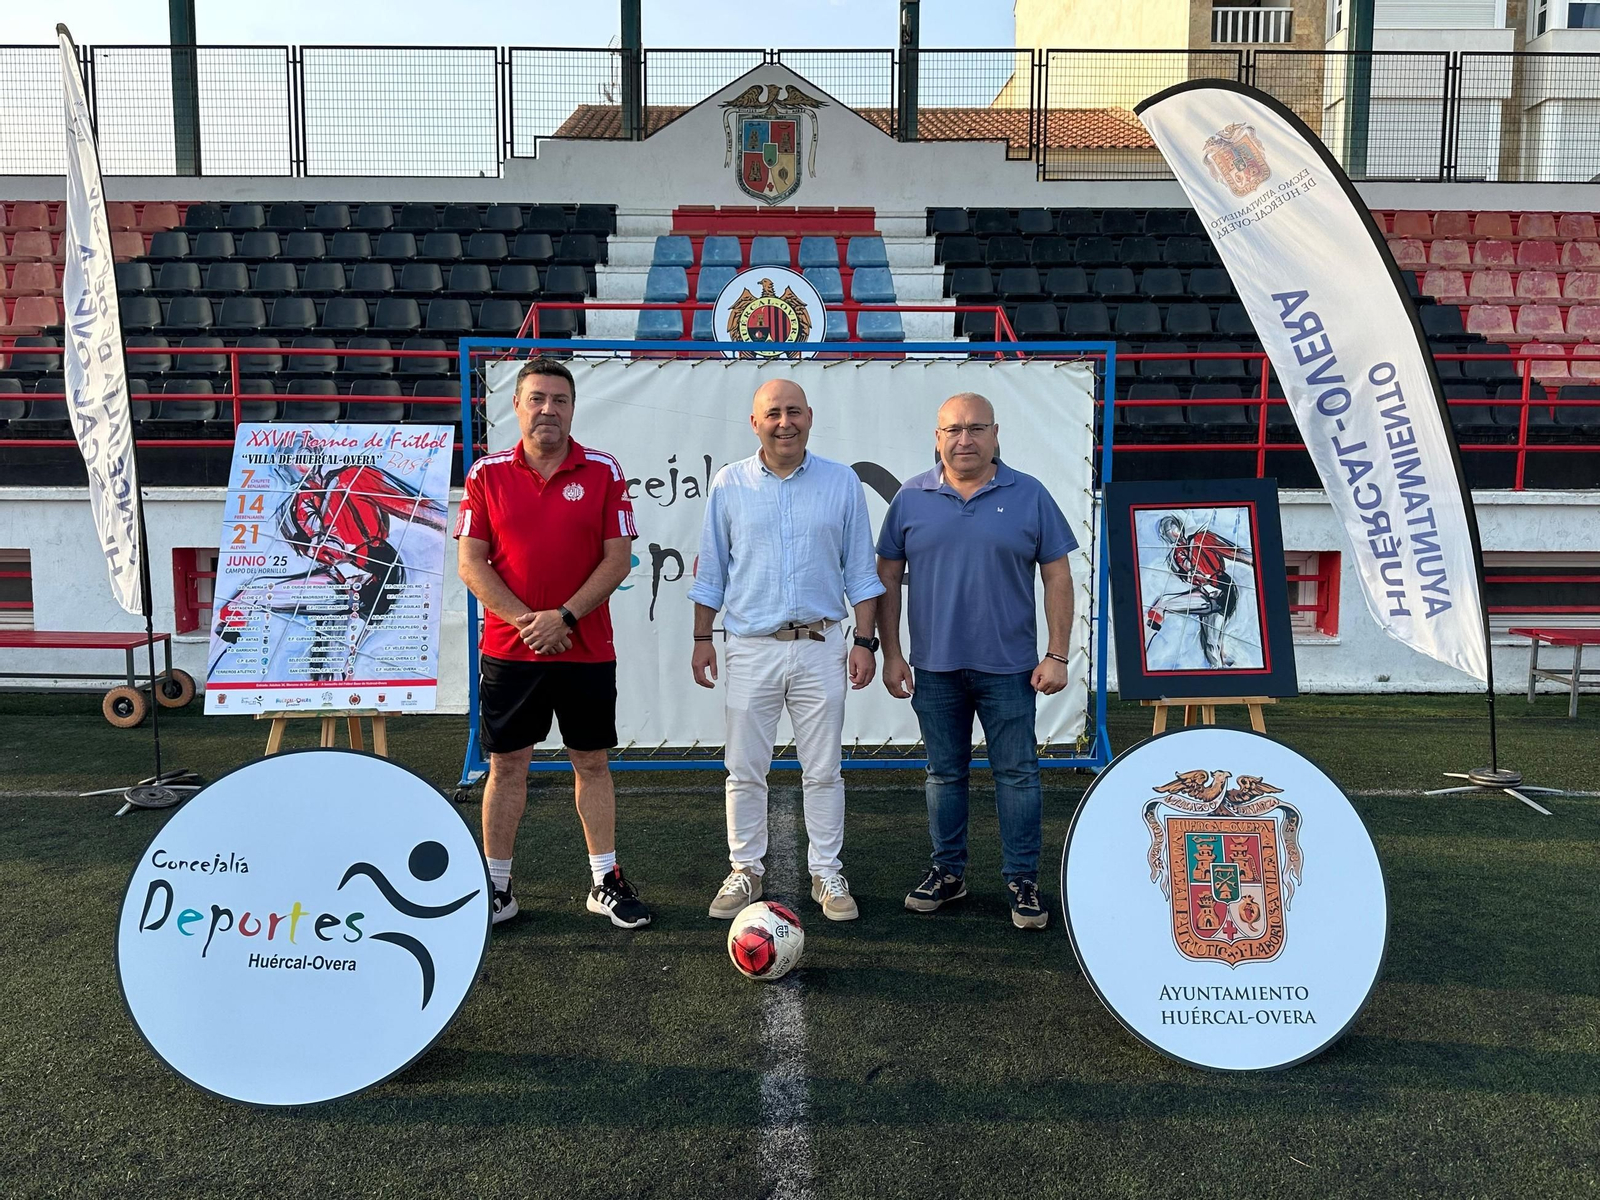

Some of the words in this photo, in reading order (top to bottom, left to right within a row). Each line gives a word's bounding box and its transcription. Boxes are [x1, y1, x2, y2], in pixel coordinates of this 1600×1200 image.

[246, 429, 296, 447] XXVII
[302, 430, 357, 448] Torneo
[364, 432, 383, 448] de
[390, 431, 448, 450] Fútbol
[278, 454, 292, 465] DE
[241, 470, 255, 488] 7
[626, 454, 712, 507] cejal
[237, 494, 264, 514] 14
[232, 523, 259, 544] 21
[226, 555, 266, 566] JUNIO
[151, 849, 249, 875] Concejalía
[139, 879, 365, 958] Deportes
[248, 953, 357, 972] Huércal-Overa
[1158, 983, 1309, 1001] AYUNTAMIENTO
[1161, 1006, 1317, 1025] HUÉRCAL-OVERA
